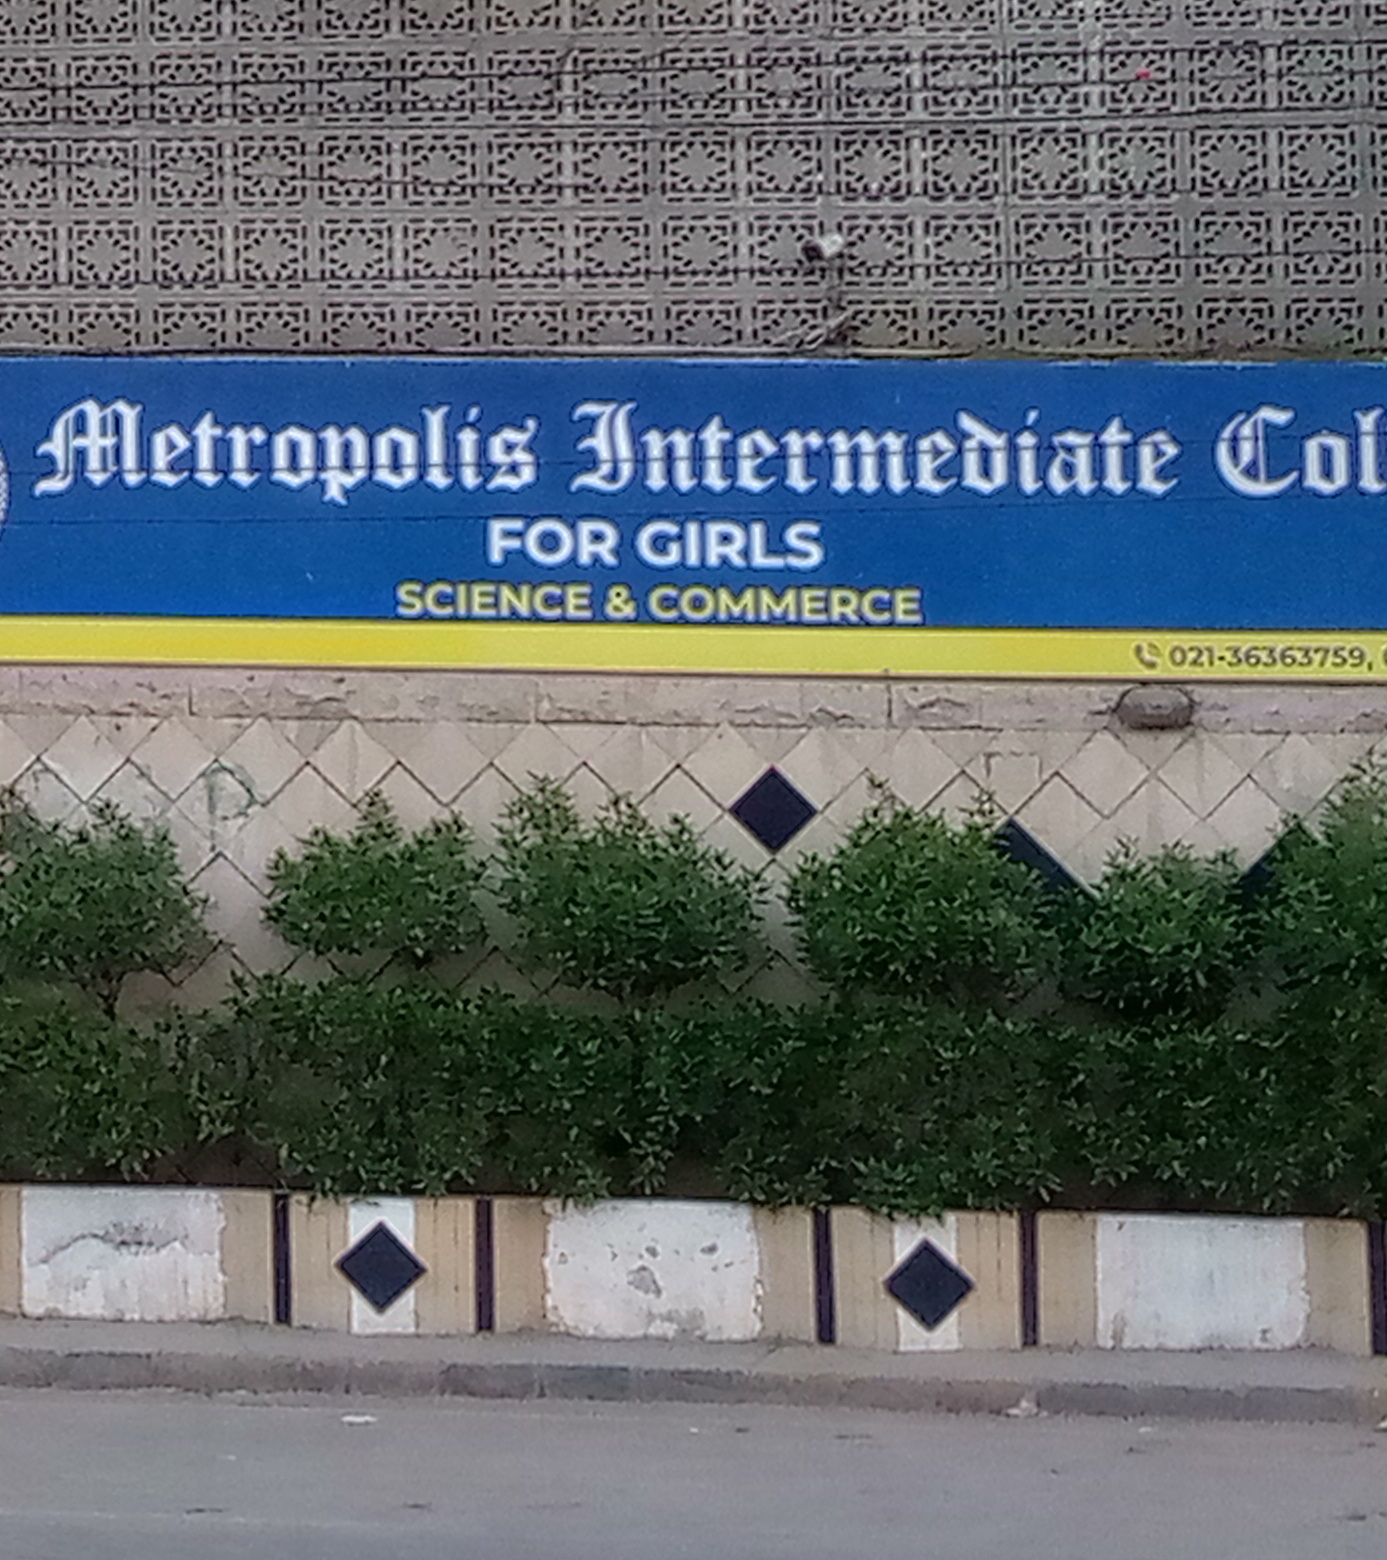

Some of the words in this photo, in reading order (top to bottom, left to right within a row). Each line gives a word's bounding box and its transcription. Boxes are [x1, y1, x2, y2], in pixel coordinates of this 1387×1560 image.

[34, 396, 540, 504] Metropolis
[570, 401, 1183, 496] Intermediate
[487, 518, 619, 567] FOR
[636, 519, 825, 571] GIRLS
[396, 582, 593, 619] SCIENCE
[604, 583, 637, 620] &
[647, 586, 923, 625] COMMERCE
[1169, 644, 1374, 672] 021-36363759,
